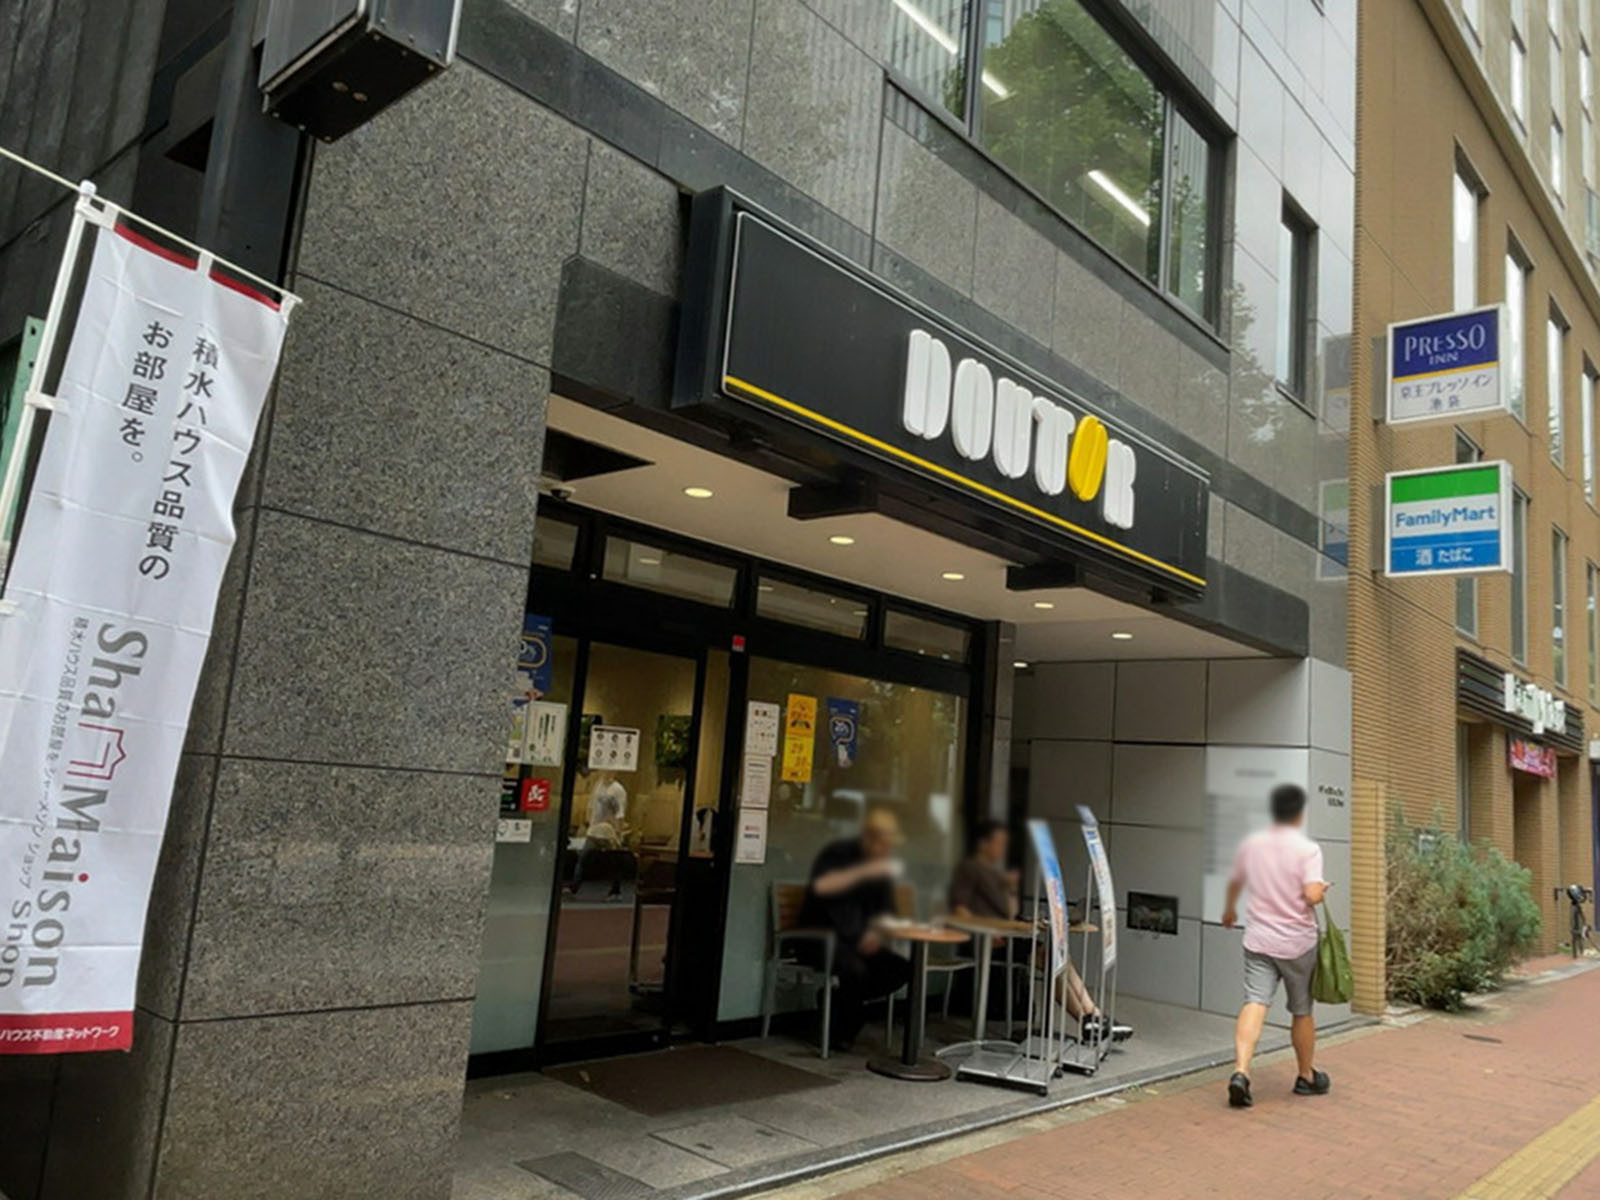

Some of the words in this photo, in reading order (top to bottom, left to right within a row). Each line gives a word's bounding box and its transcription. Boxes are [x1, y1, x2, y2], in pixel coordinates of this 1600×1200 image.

[119, 321, 174, 463] お部屋を。
[1404, 323, 1486, 362] PRESSO
[1429, 351, 1459, 365] INN
[139, 336, 219, 580] 積水ハウス品質の
[903, 329, 1136, 529] DOUTOR
[1394, 504, 1497, 528] FamilyMart
[22, 783, 110, 989] Maison
